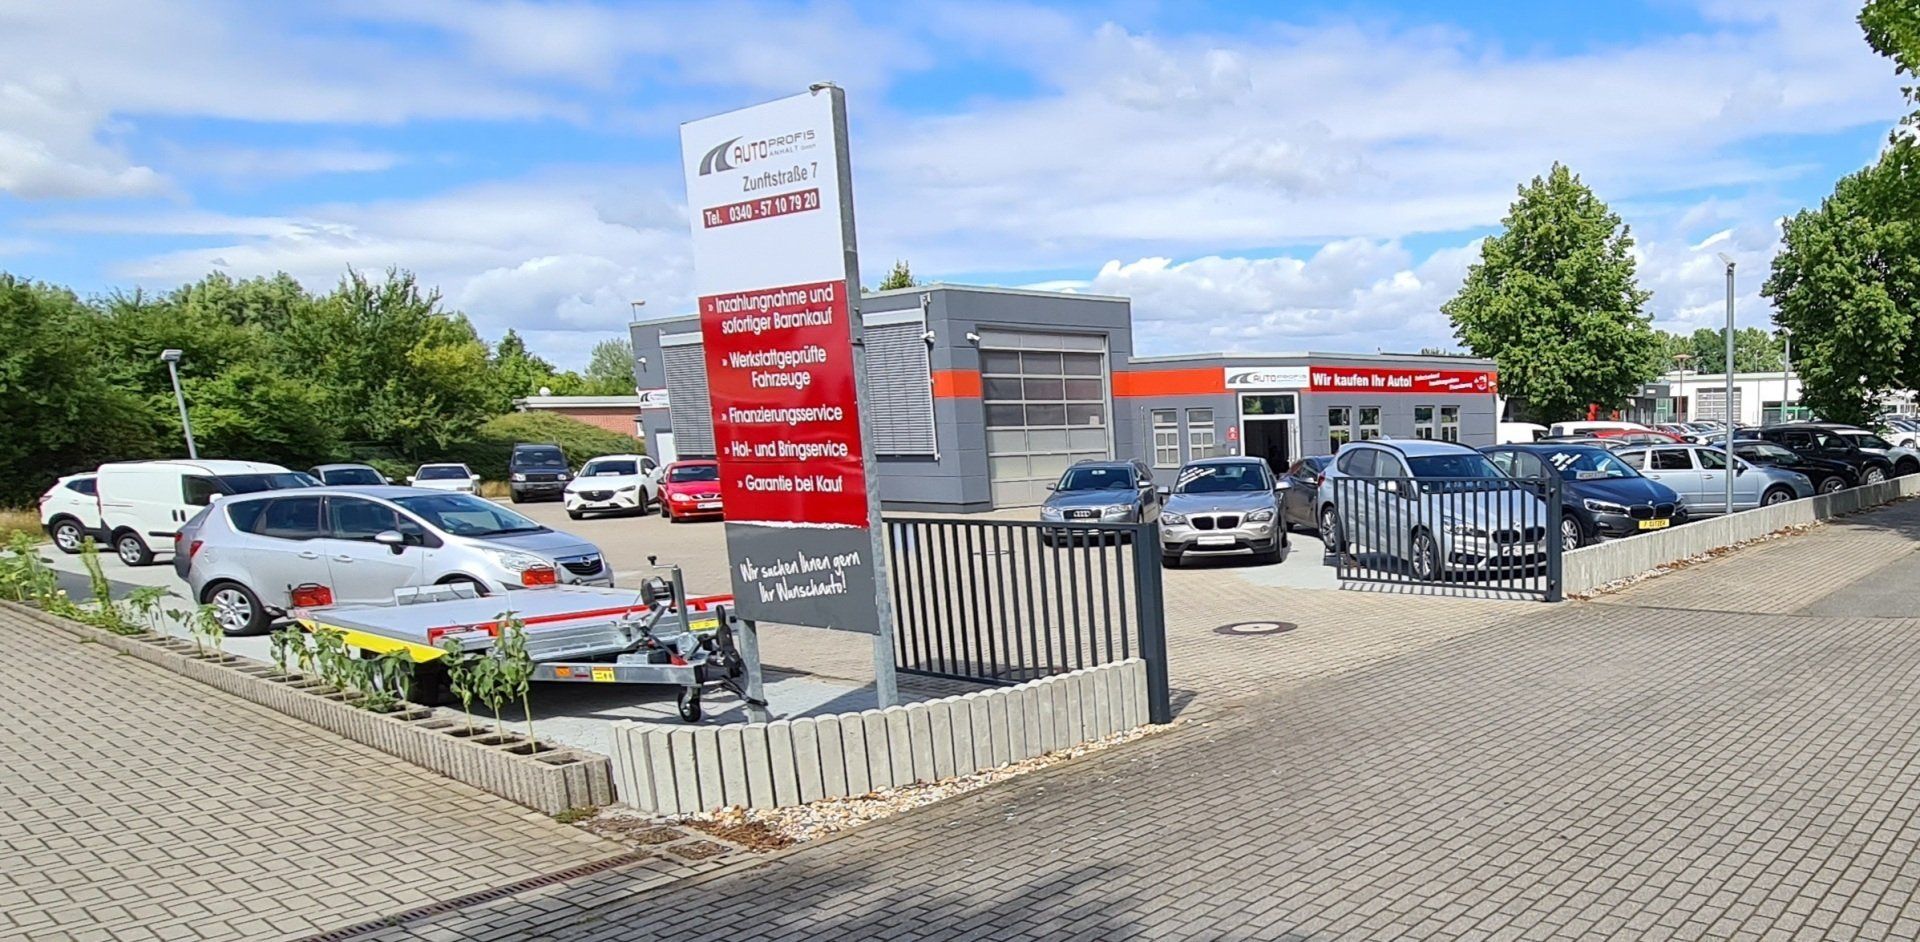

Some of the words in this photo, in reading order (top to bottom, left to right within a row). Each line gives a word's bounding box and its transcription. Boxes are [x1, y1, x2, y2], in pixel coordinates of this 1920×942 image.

[743, 165, 807, 191] Zunftstraße
[811, 162, 818, 178] 7
[705, 210, 722, 225] Tel.
[729, 204, 752, 222] 0340
[760, 200, 771, 216] 57
[775, 197, 787, 213] 10
[789, 194, 801, 211] 79
[804, 191, 817, 209] 20
[716, 289, 806, 313] Inzahlungnahme
[809, 283, 834, 303] und
[722, 315, 771, 335] sofortiger
[774, 307, 833, 329] Barankauf
[729, 345, 826, 369] Werkstattgeprüfte
[752, 371, 811, 389] Fahrzeuge
[1312, 372, 1331, 386] Wir
[1334, 373, 1369, 387] kaufen
[1371, 374, 1385, 387] Ihr
[1387, 374, 1412, 388] Auto!
[728, 403, 843, 425] Finanzierungsservice
[731, 441, 752, 457] Hol-
[755, 441, 775, 457] und
[778, 440, 848, 461] Bringservice
[745, 474, 792, 491] Garantie
[795, 475, 813, 492] bei
[816, 475, 843, 492] Kauf
[740, 557, 759, 582] Wir
[761, 558, 798, 579] suchen
[799, 551, 831, 574] Ihnen
[833, 551, 860, 577] gern
[759, 581, 775, 603] Ihr
[775, 571, 847, 602] Wunschauto!
